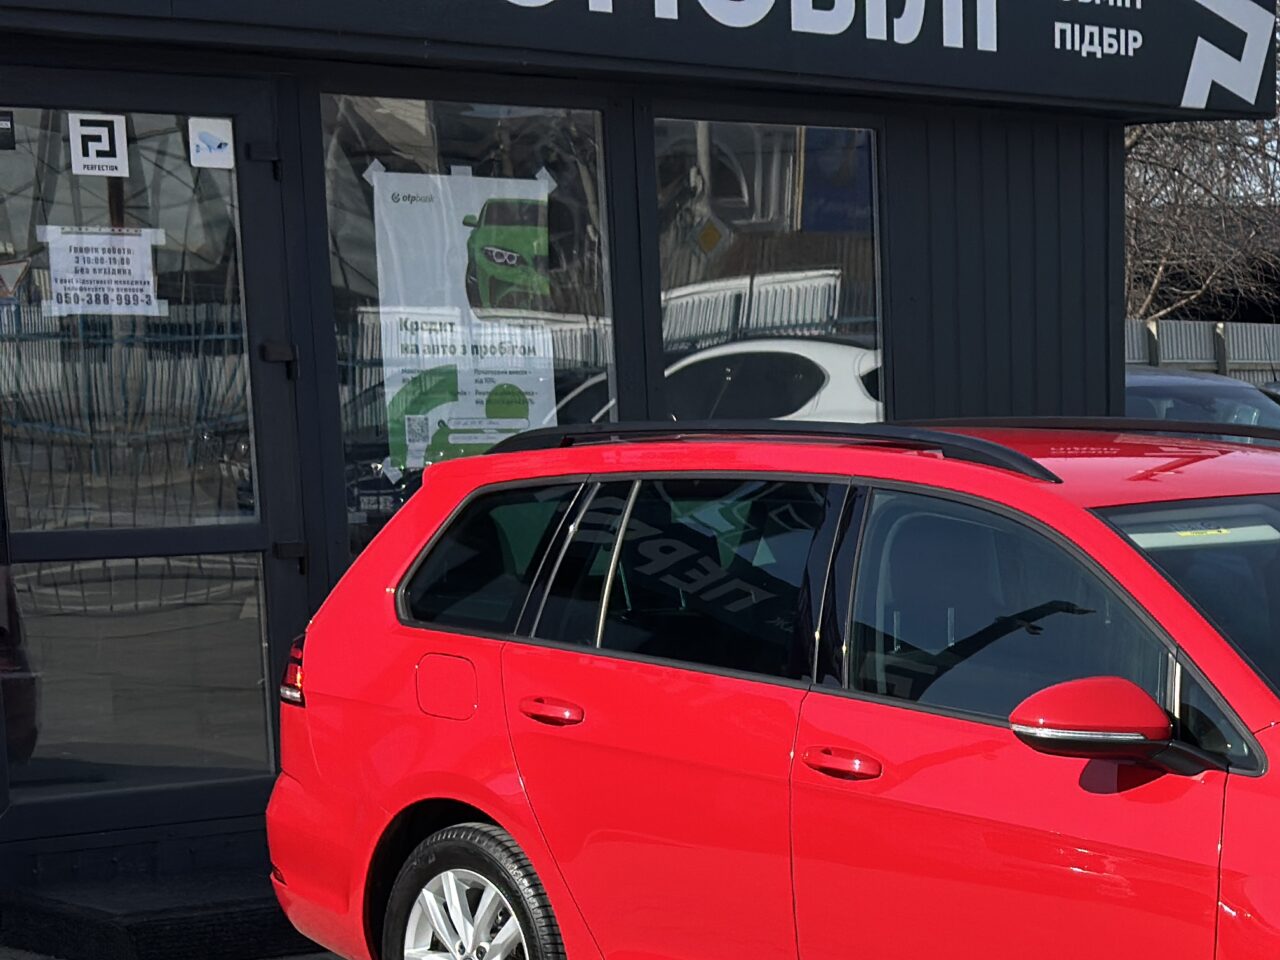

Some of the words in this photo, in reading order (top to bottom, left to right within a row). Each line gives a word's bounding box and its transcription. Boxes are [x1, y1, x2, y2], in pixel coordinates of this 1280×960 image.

[1054, 21, 1143, 58] ПІДБІР
[400, 317, 456, 335] Кредит
[400, 343, 419, 355] на
[422, 344, 457, 356] авто
[471, 341, 537, 359] пробігом
